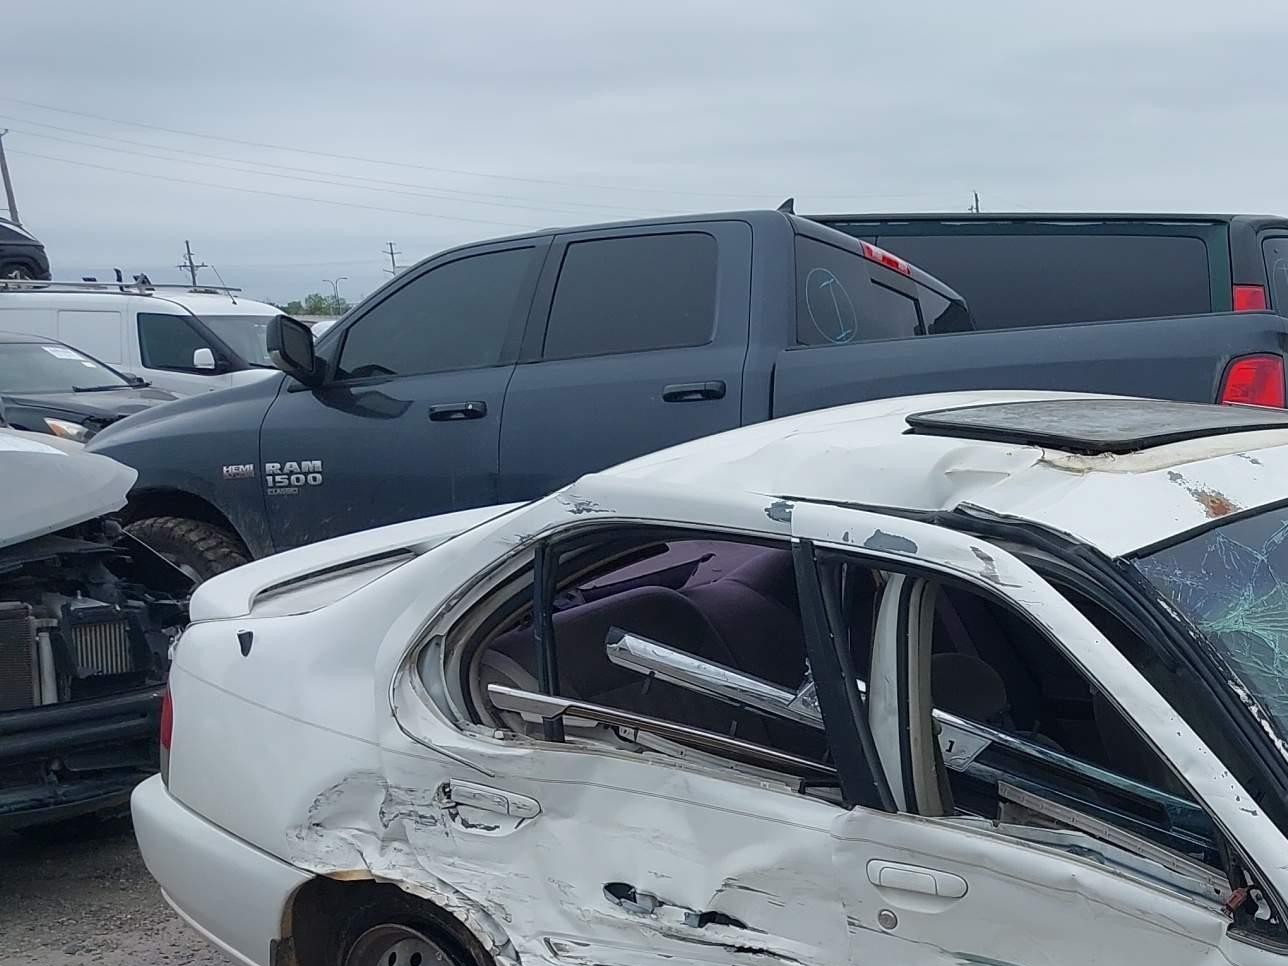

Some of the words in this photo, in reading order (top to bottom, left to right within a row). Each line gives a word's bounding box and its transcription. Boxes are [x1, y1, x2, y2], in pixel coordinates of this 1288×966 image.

[223, 463, 254, 474] HEMI
[265, 460, 323, 474] RAM
[265, 473, 323, 487] 1500
